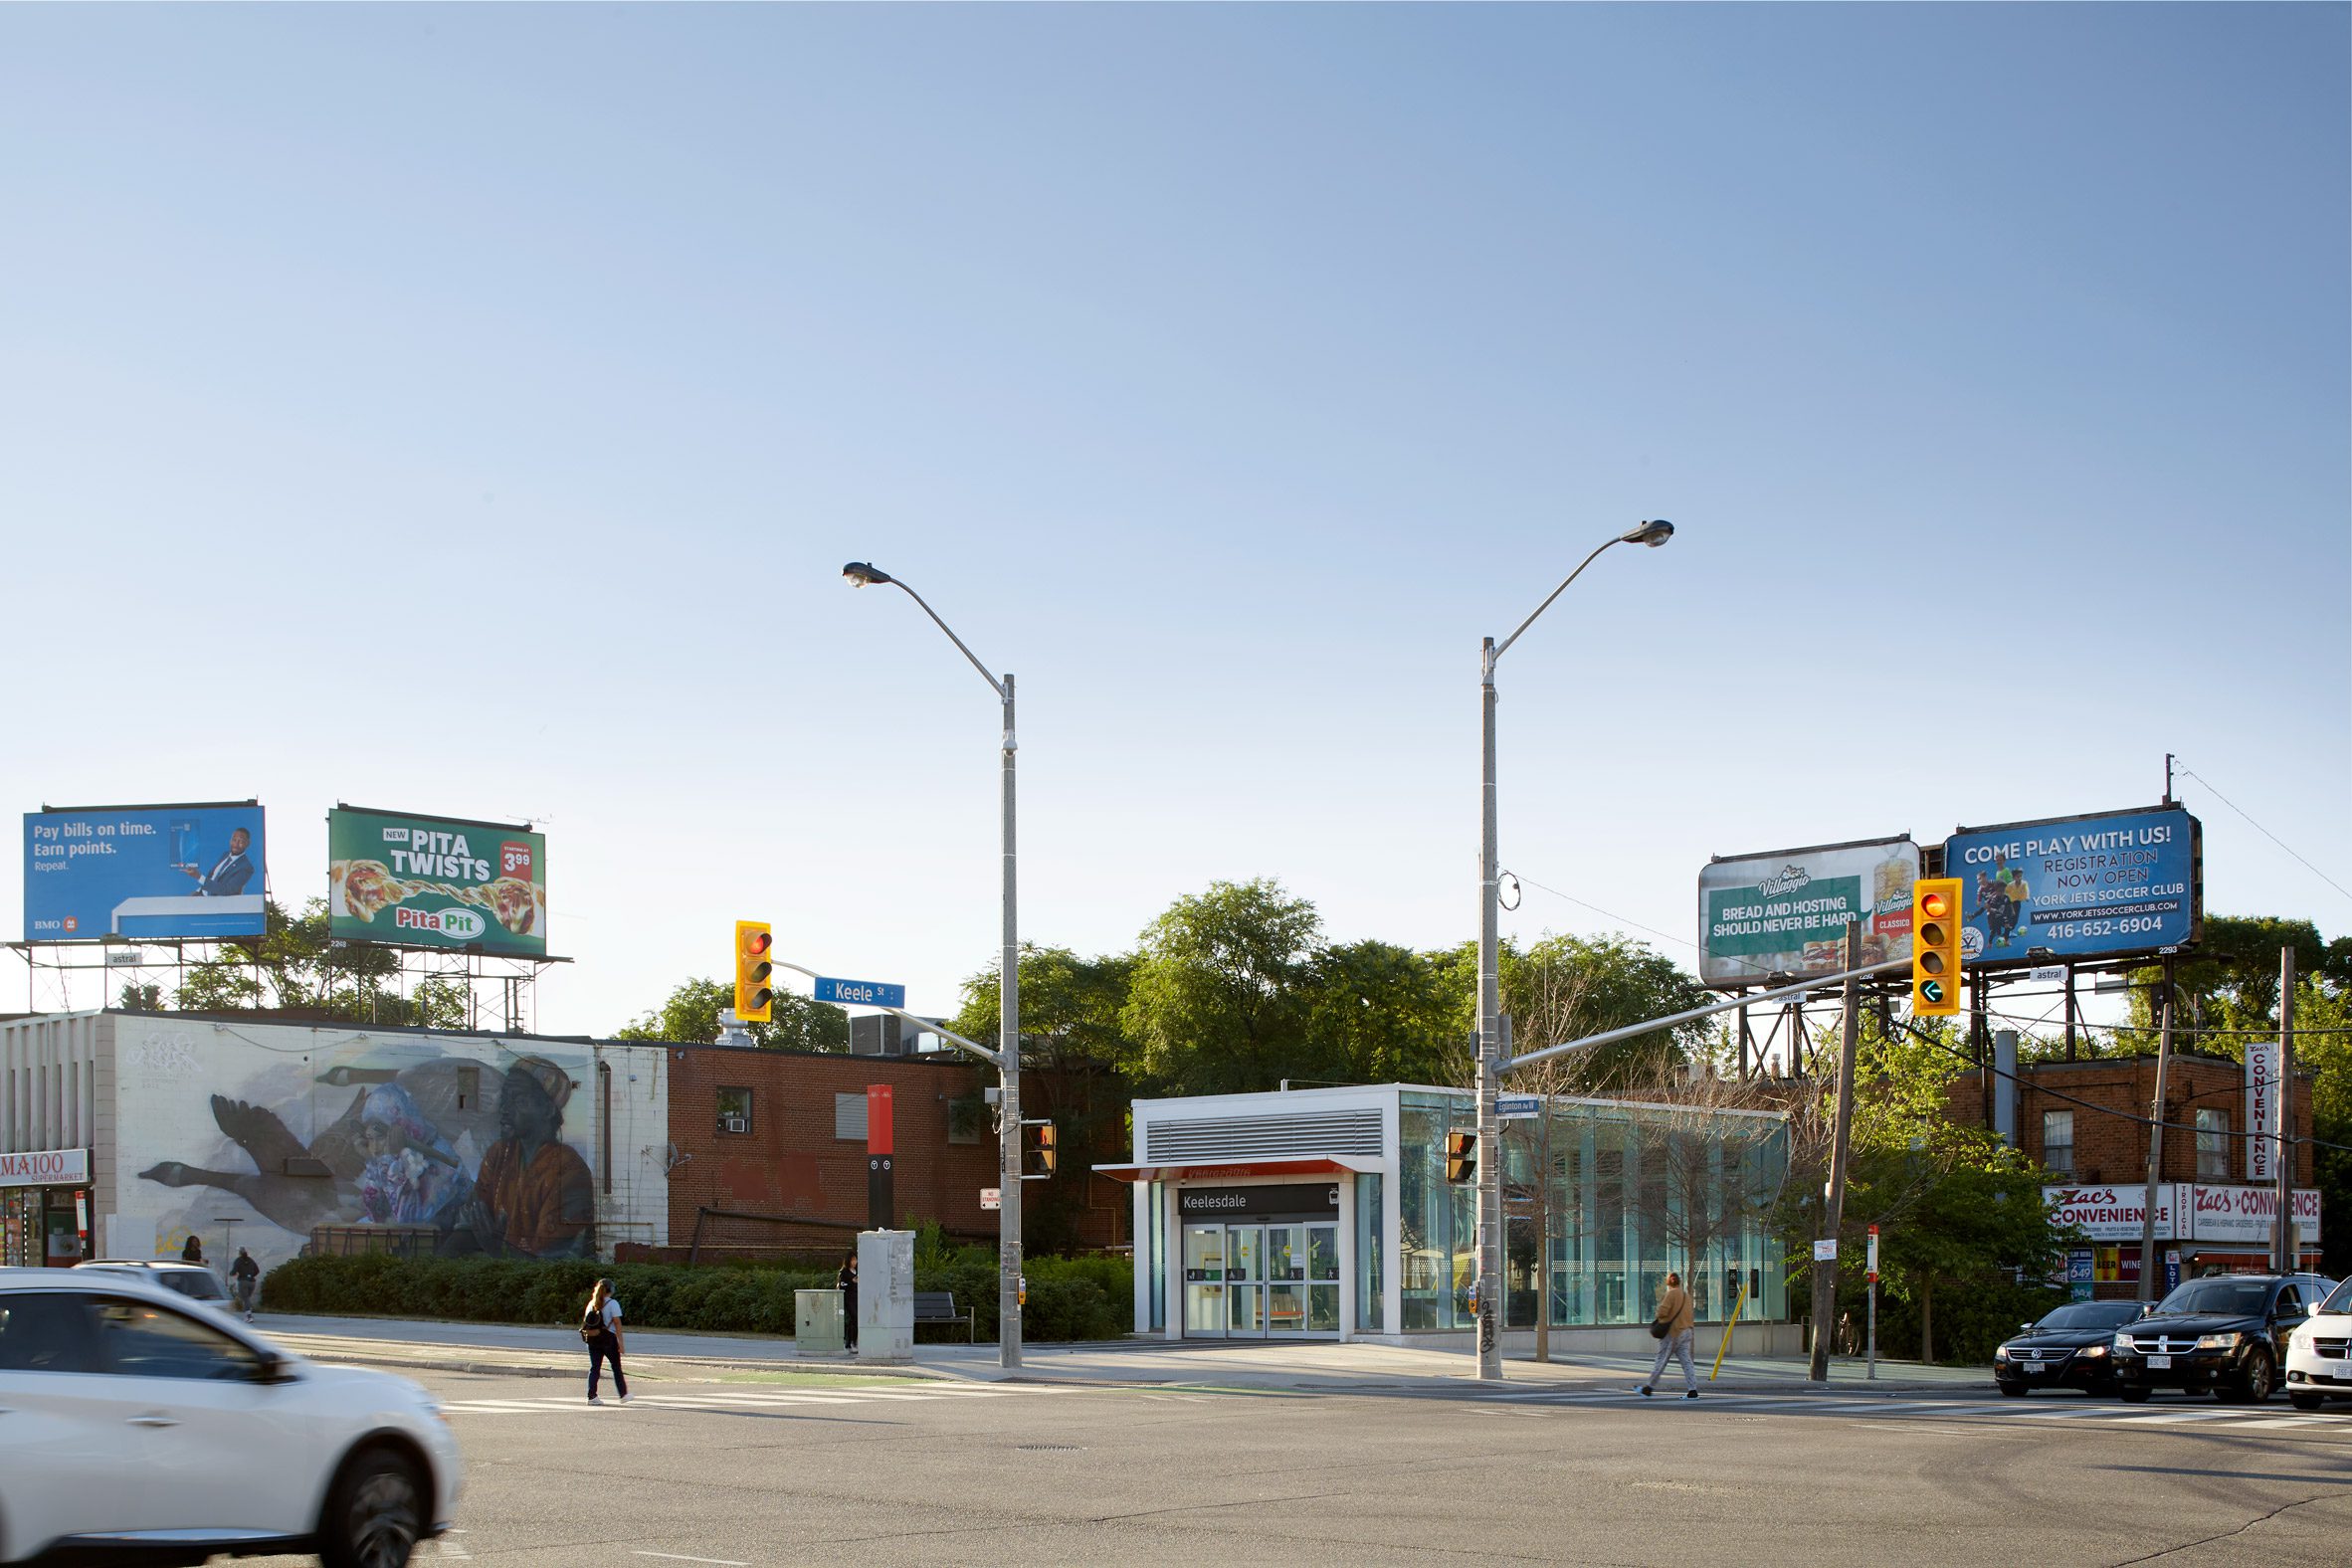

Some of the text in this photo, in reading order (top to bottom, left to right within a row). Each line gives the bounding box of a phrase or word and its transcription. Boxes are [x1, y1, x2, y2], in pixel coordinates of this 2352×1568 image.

[34, 825, 59, 841] Pay
[64, 823, 93, 838] bills
[98, 824, 115, 837] on
[120, 822, 157, 836] time.
[34, 842, 117, 859] Earn points.
[412, 830, 471, 858] PITA
[1965, 826, 2171, 865] COME PLAY WITH US!
[390, 850, 490, 882] TWISTS
[2045, 848, 2158, 873] REGISTRATION
[1758, 875, 1811, 897] Villaggio
[2058, 868, 2149, 888] NOW OPEN
[2033, 882, 2185, 906] YORK JETS SOCCER CLUB
[1722, 896, 1847, 921] BREAD AND HOSTING
[2033, 901, 2178, 921] WWW.YORKJETSSOCCERCLUB.COM
[35, 920, 60, 929] BMO
[397, 908, 474, 932] Pita Pit
[1713, 919, 1761, 937] SHOULD
[1763, 915, 1803, 933] NEVER
[1805, 913, 1820, 928] BE
[1879, 918, 1910, 928] CLASSICO
[2047, 916, 2163, 939] 416-652-6904
[112, 954, 137, 963] astral
[2037, 970, 2061, 979] astral
[836, 983, 884, 1002] Keele St
[1498, 1101, 1521, 1112] Eglinton
[2253, 1054, 2266, 1175] CONVENIENCE
[31, 1172, 84, 1183] SUPERMARKET
[1184, 1194, 1247, 1208] Keelesdale
[2060, 1189, 2117, 1205] Zac's
[2195, 1188, 2232, 1212] Zac's
